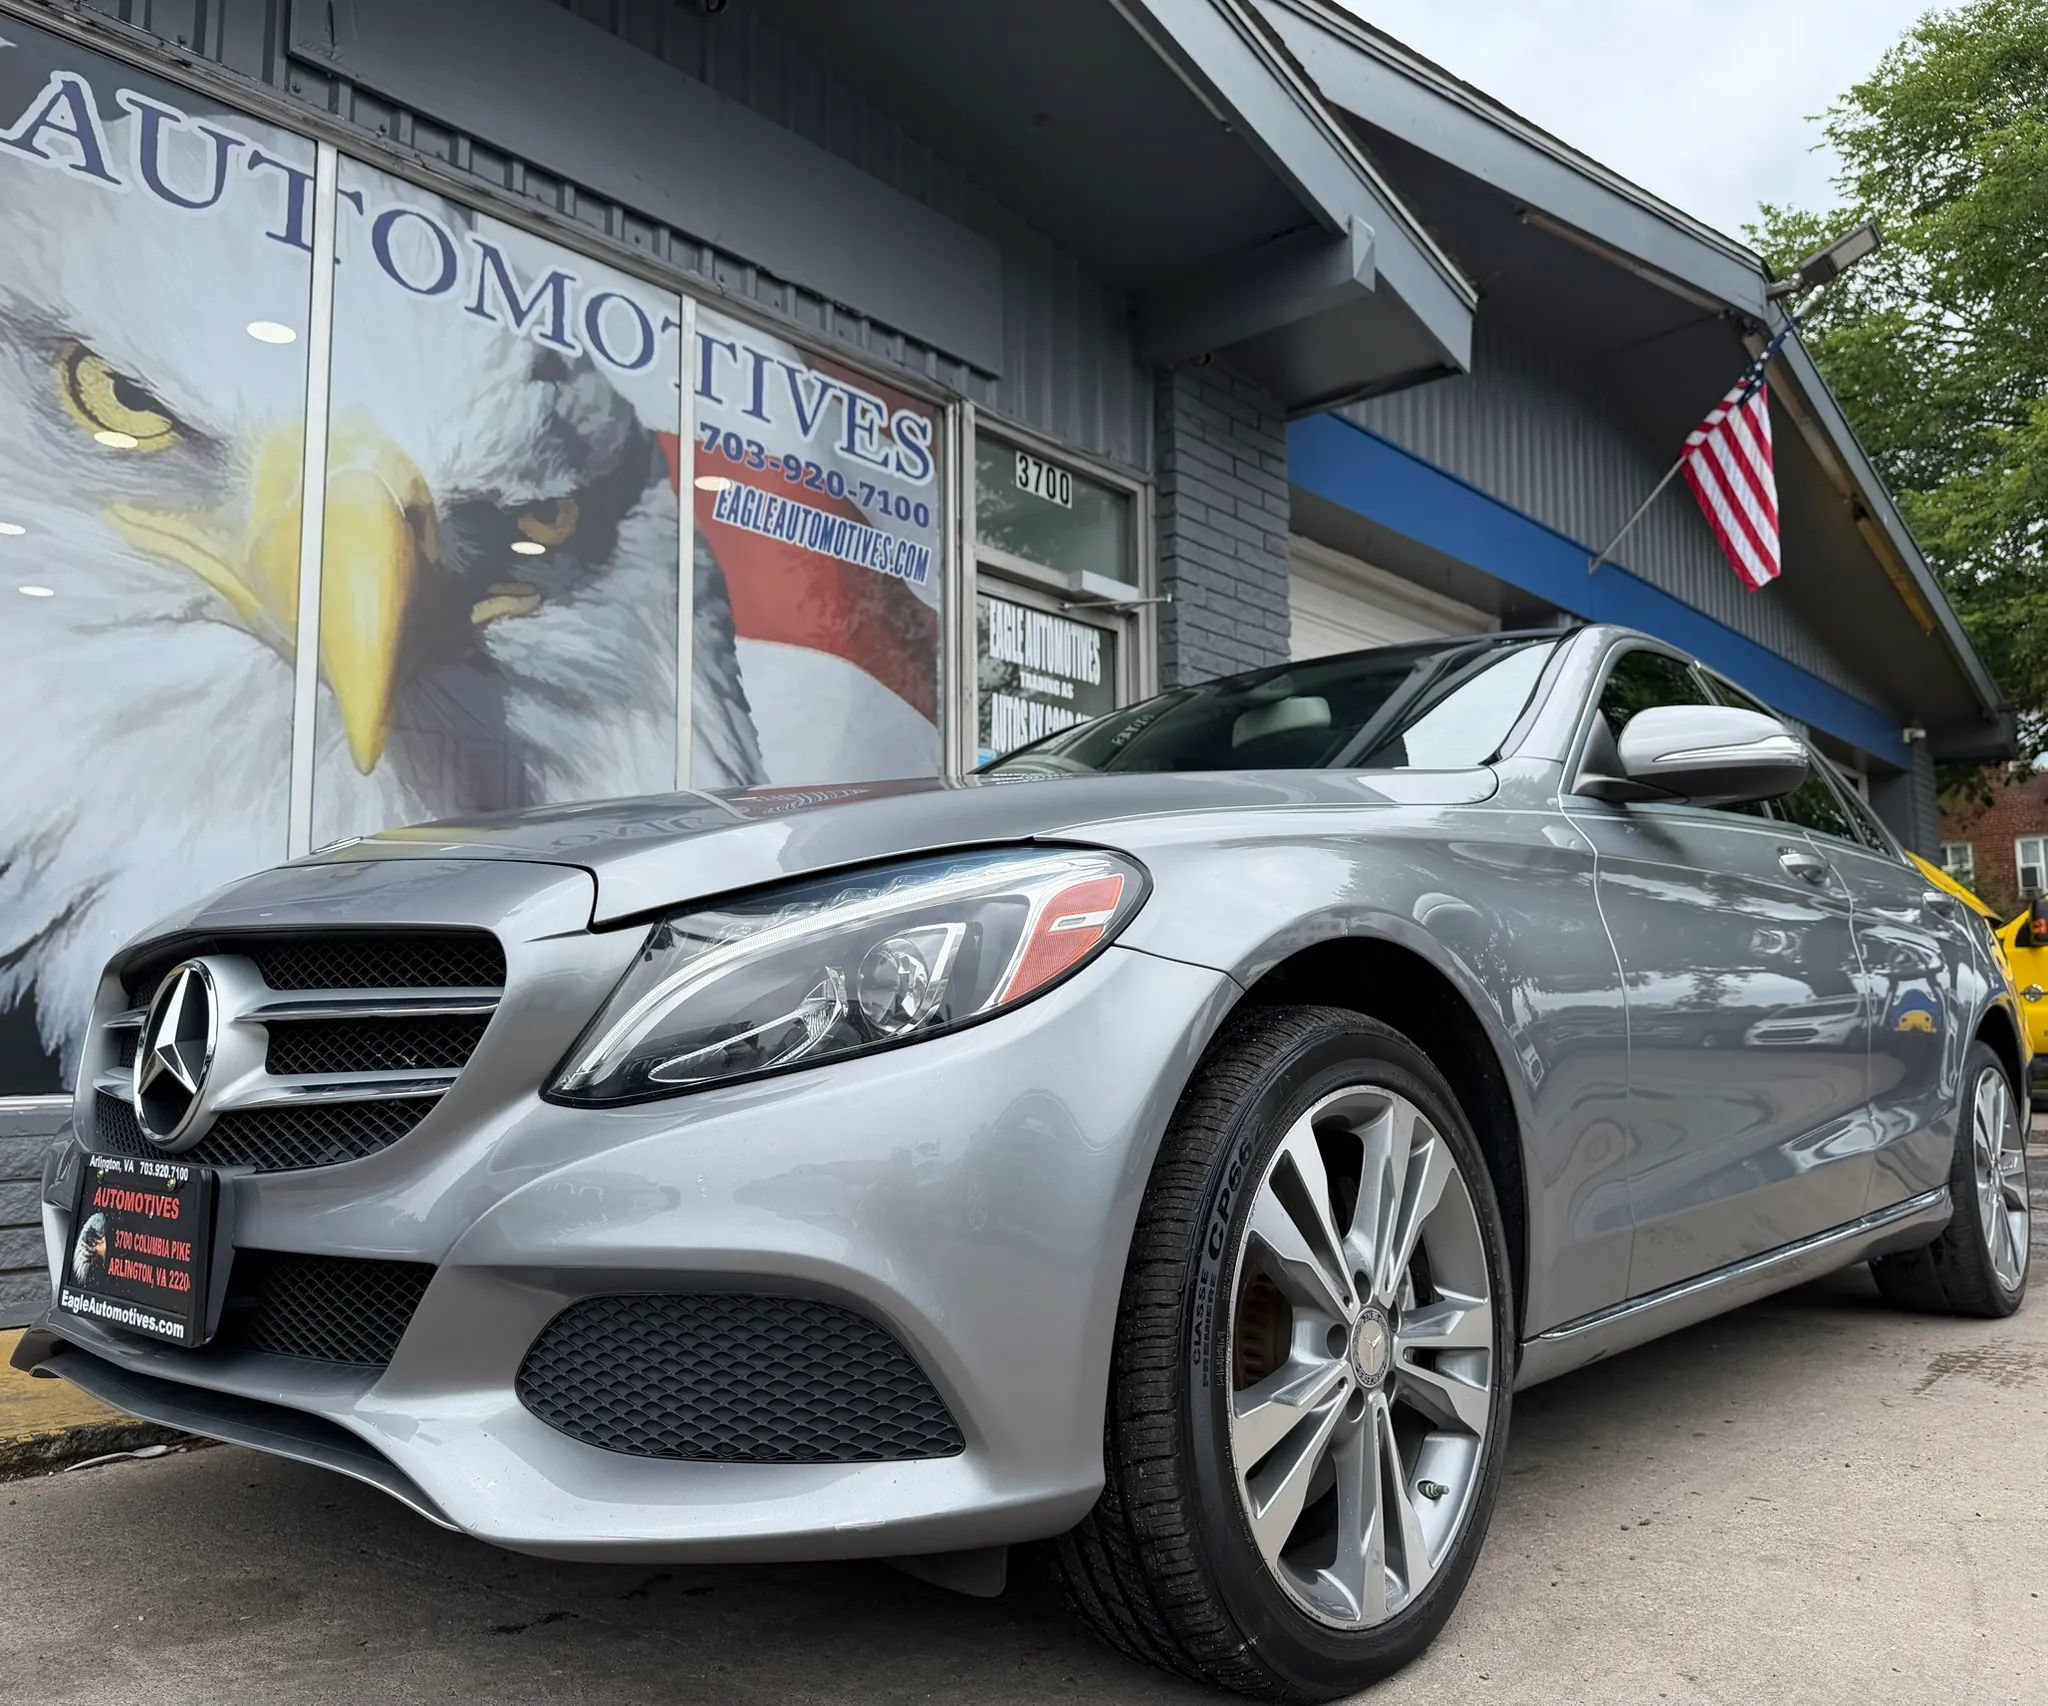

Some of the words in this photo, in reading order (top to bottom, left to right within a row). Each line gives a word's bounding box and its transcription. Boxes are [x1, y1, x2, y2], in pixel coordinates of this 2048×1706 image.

[0, 74, 931, 482] AUTOMOTIVES
[700, 422, 930, 528] 703-920-7100
[1018, 454, 1071, 506] 3700
[714, 483, 931, 583] EAGLEAUTOMOTIVES.COM
[989, 599, 1024, 665] EAGLE
[1025, 609, 1101, 686] AUTOMOTIVES
[1020, 671, 1060, 697] TRADING
[1061, 681, 1074, 700] AS
[991, 692, 1028, 753] AUTOS
[89, 1154, 122, 1173] Arlington,
[124, 1159, 135, 1173] VA
[140, 1161, 189, 1181] 703.920.7100
[93, 1187, 180, 1220] AUTOMOTIVES
[114, 1230, 133, 1250] 3700
[134, 1233, 170, 1259] COLUMBIA
[171, 1240, 191, 1262] PIKE
[108, 1257, 154, 1288] ARLINGTON,
[156, 1266, 167, 1288] VA
[169, 1269, 191, 1292] 2220
[61, 1289, 184, 1339] EagleAutomotives.com
